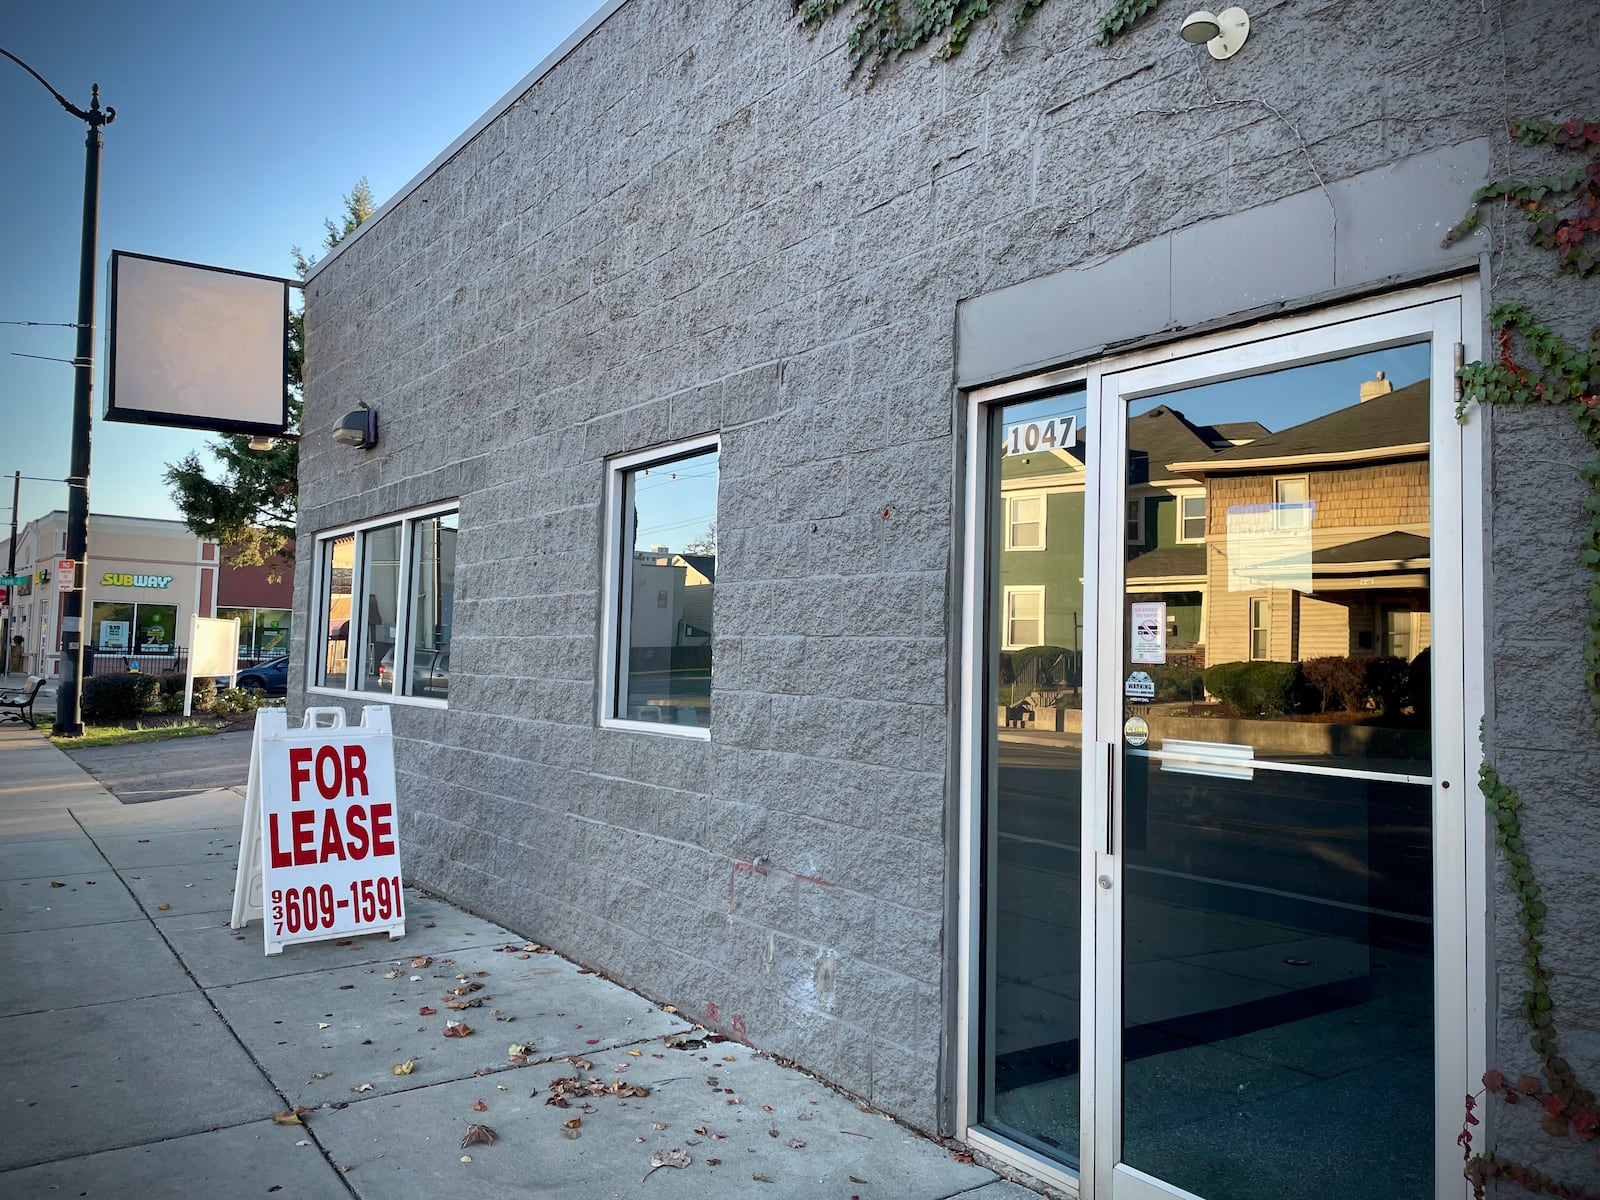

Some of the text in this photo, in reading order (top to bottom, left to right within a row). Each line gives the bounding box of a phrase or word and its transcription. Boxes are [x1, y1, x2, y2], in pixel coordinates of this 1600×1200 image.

[1011, 416, 1074, 454] 1047
[100, 573, 173, 589] SUBWAY
[289, 745, 369, 801] FOR
[269, 803, 395, 869] LEASE
[285, 876, 402, 934] 609-1591
